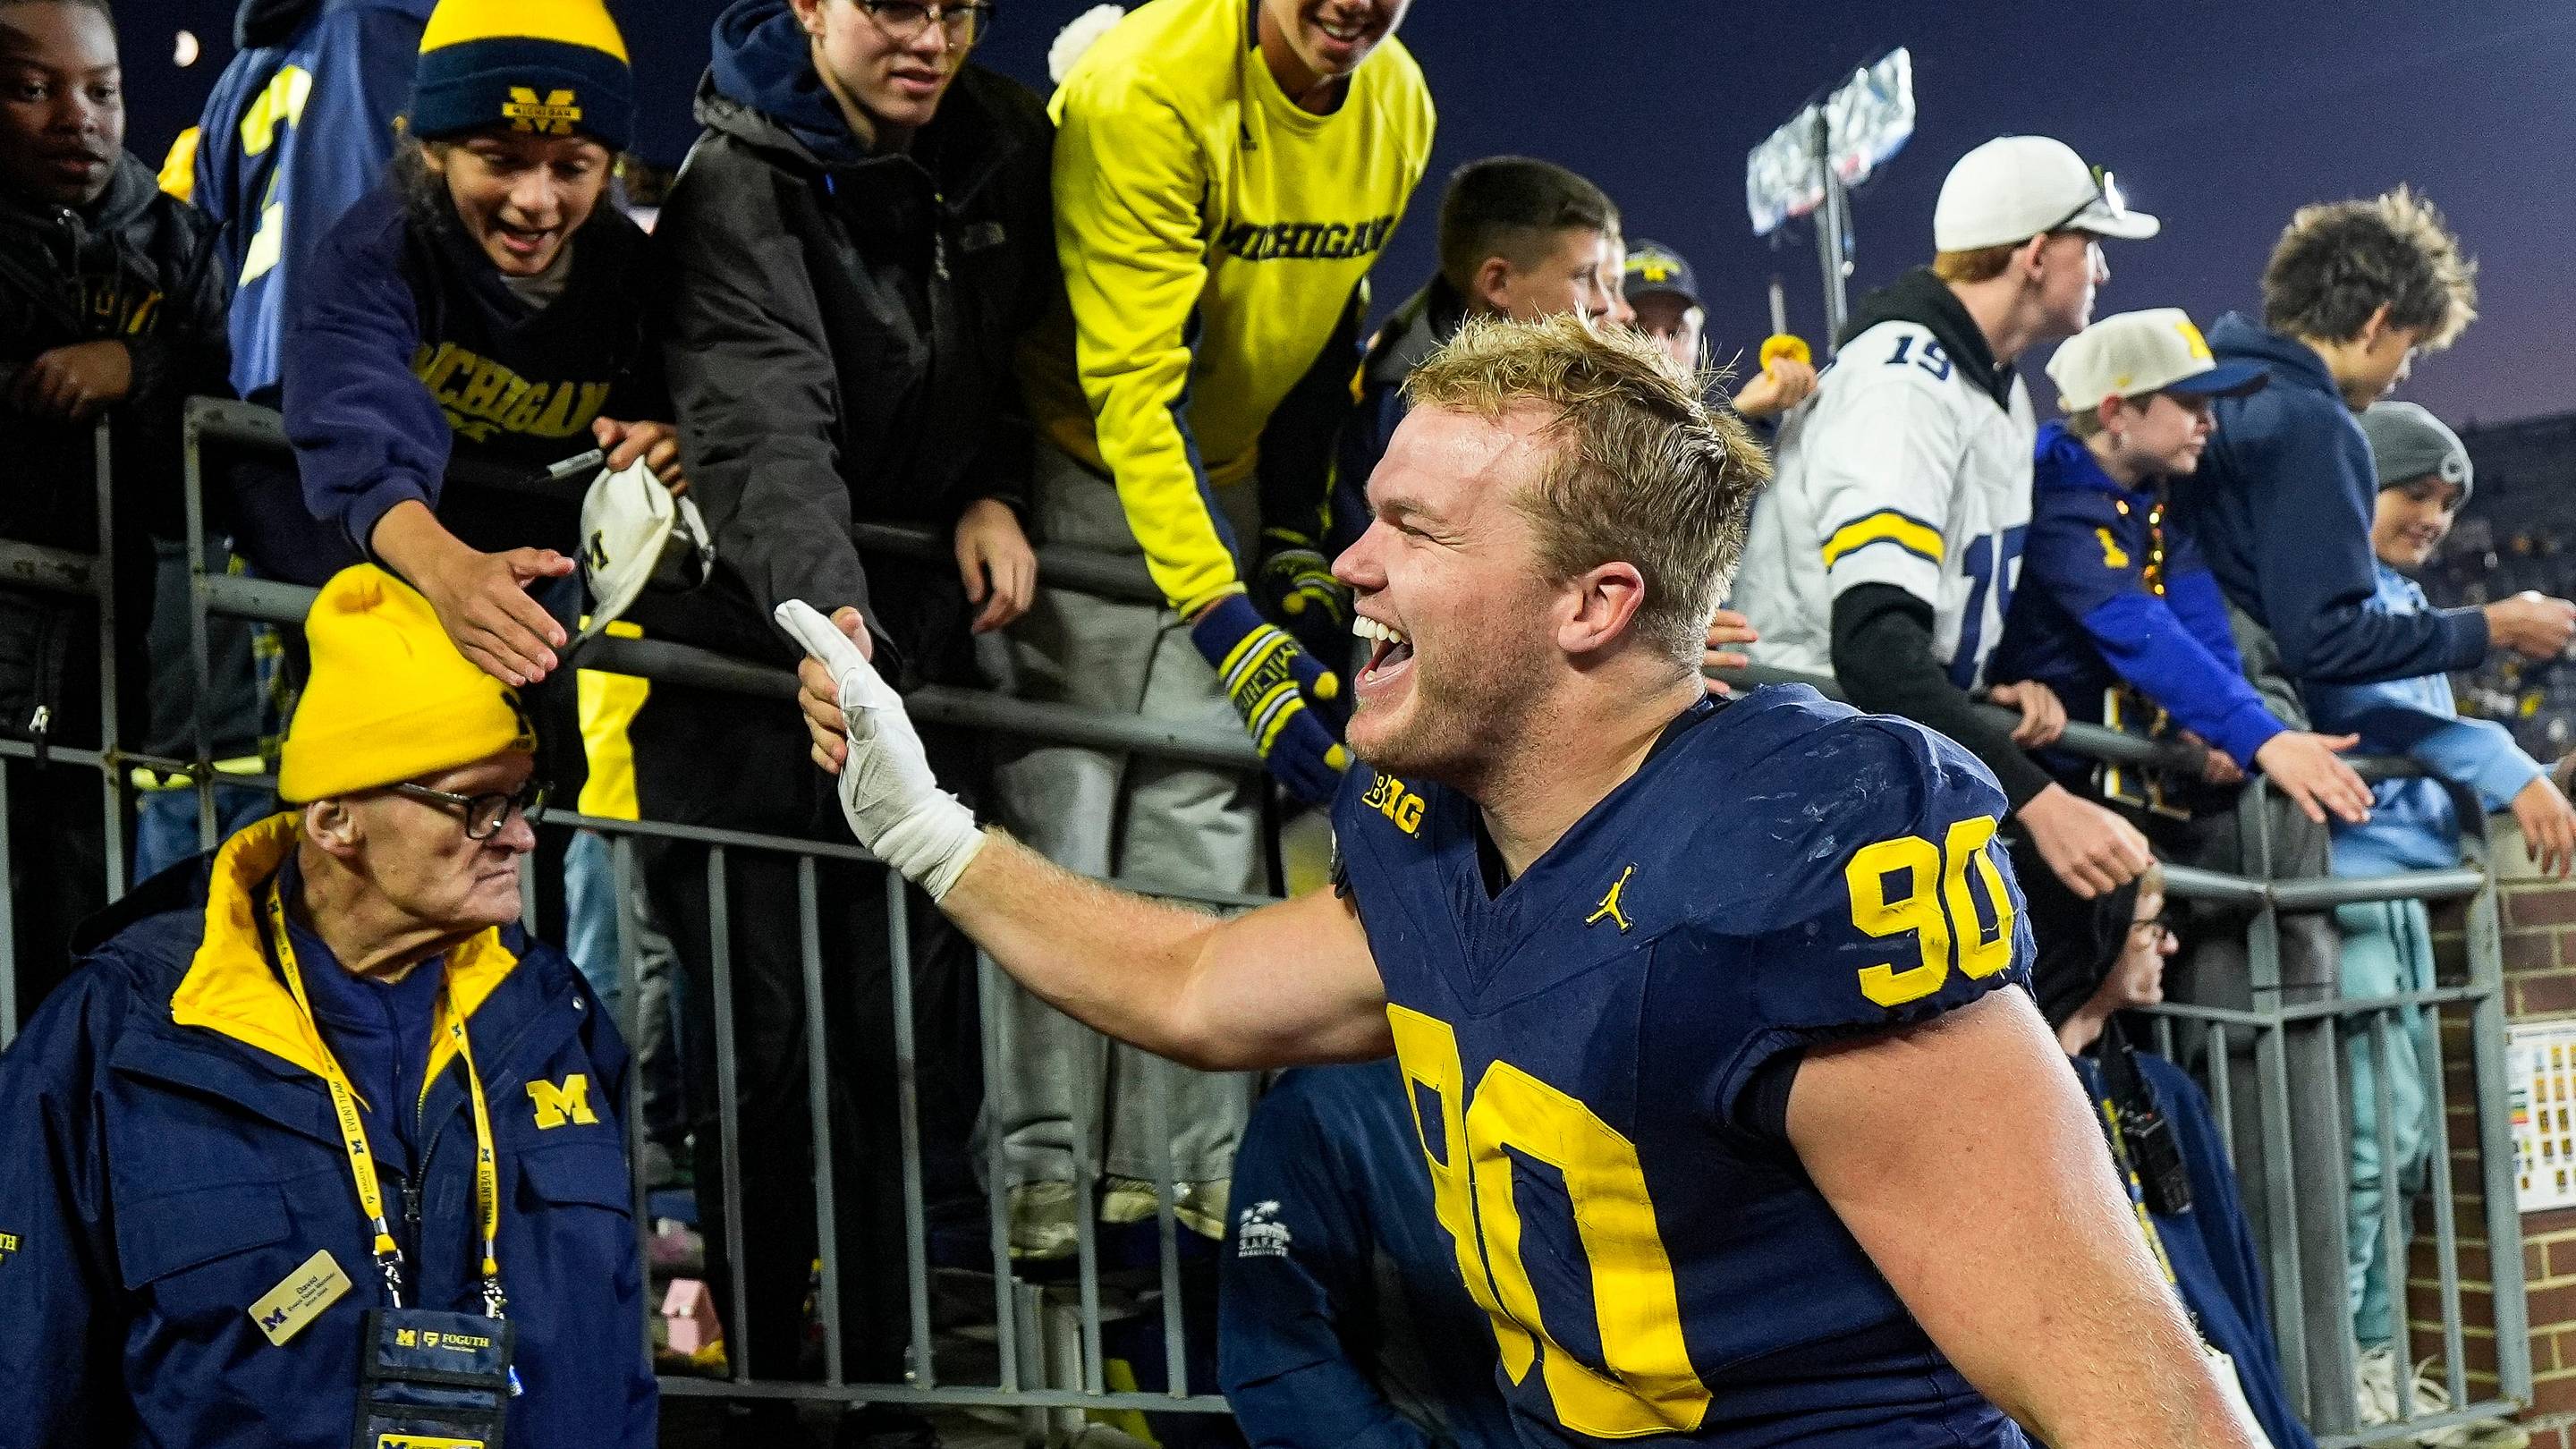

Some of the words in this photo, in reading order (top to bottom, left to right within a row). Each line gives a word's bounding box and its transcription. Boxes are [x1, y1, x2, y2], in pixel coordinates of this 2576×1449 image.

[1845, 814, 2013, 1008] 90
[526, 1073, 600, 1130] M
[1385, 1002, 1714, 1439] 90
[260, 1306, 288, 1333] M
[395, 1328, 417, 1348] M
[442, 1333, 490, 1348] FOGUTH
